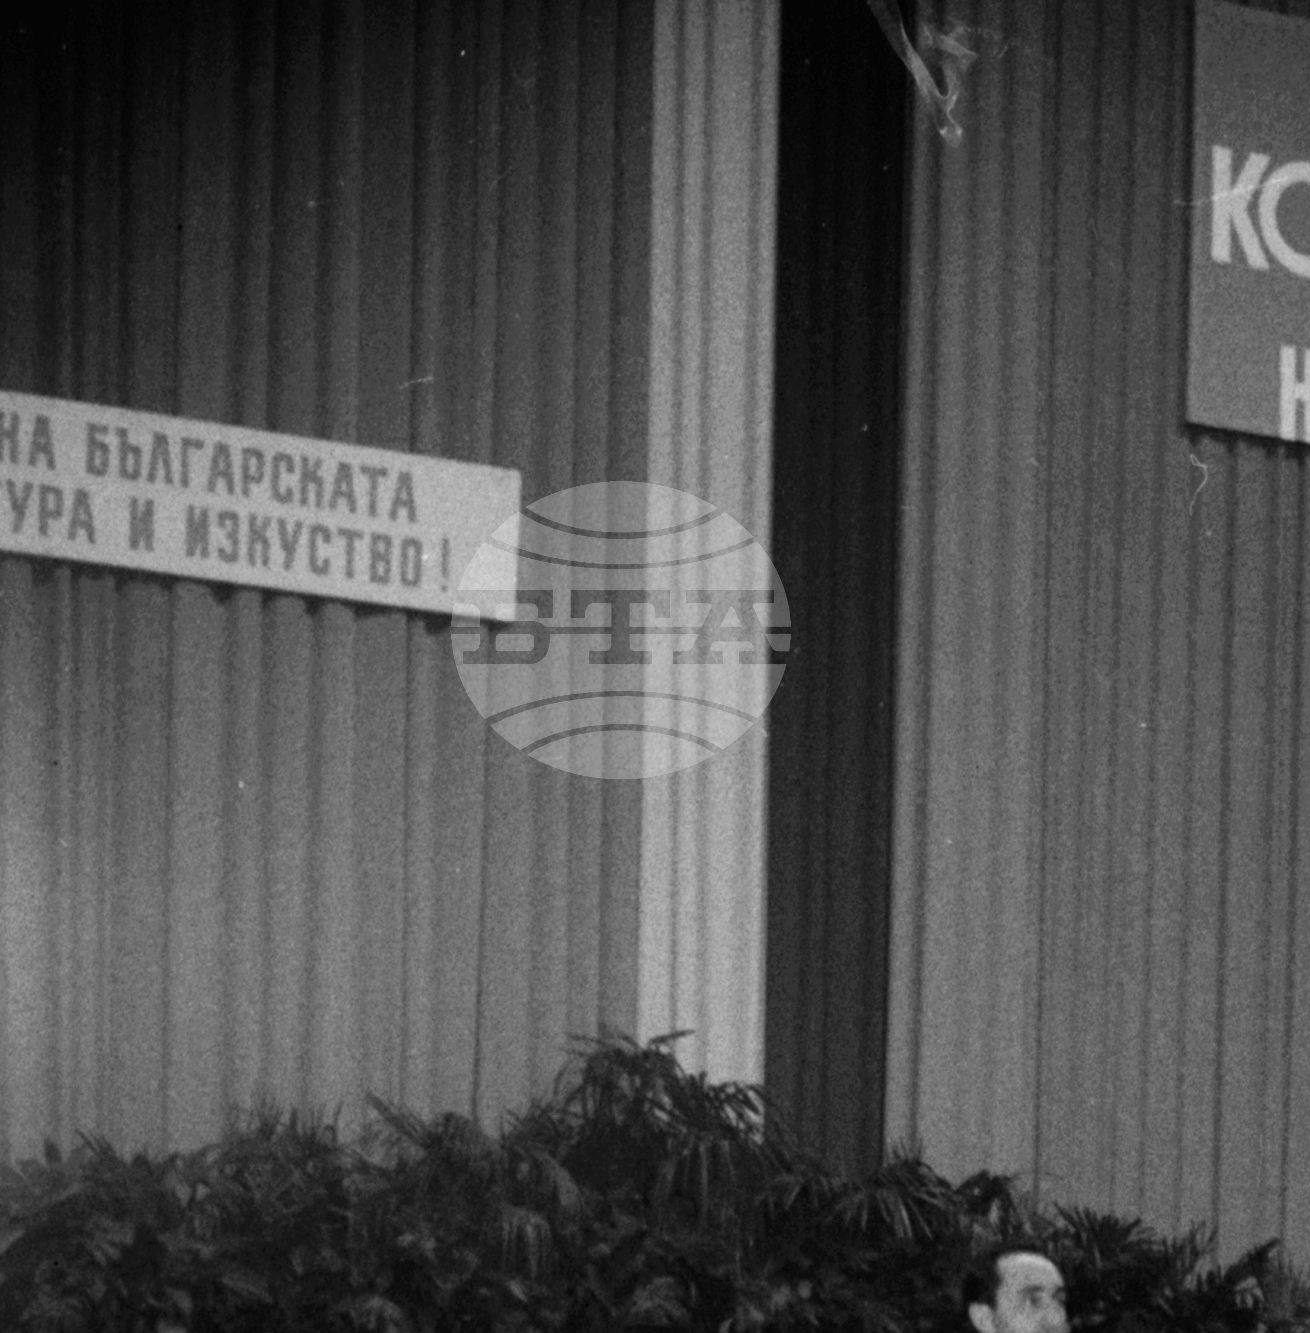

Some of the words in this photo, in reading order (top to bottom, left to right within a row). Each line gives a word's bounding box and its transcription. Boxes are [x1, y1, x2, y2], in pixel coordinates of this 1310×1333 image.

[0, 410, 56, 471] НА
[85, 422, 417, 523] БЪЛГАРСКАТА
[129, 496, 155, 552] И
[185, 504, 449, 592] ИЗКУСТВО!
